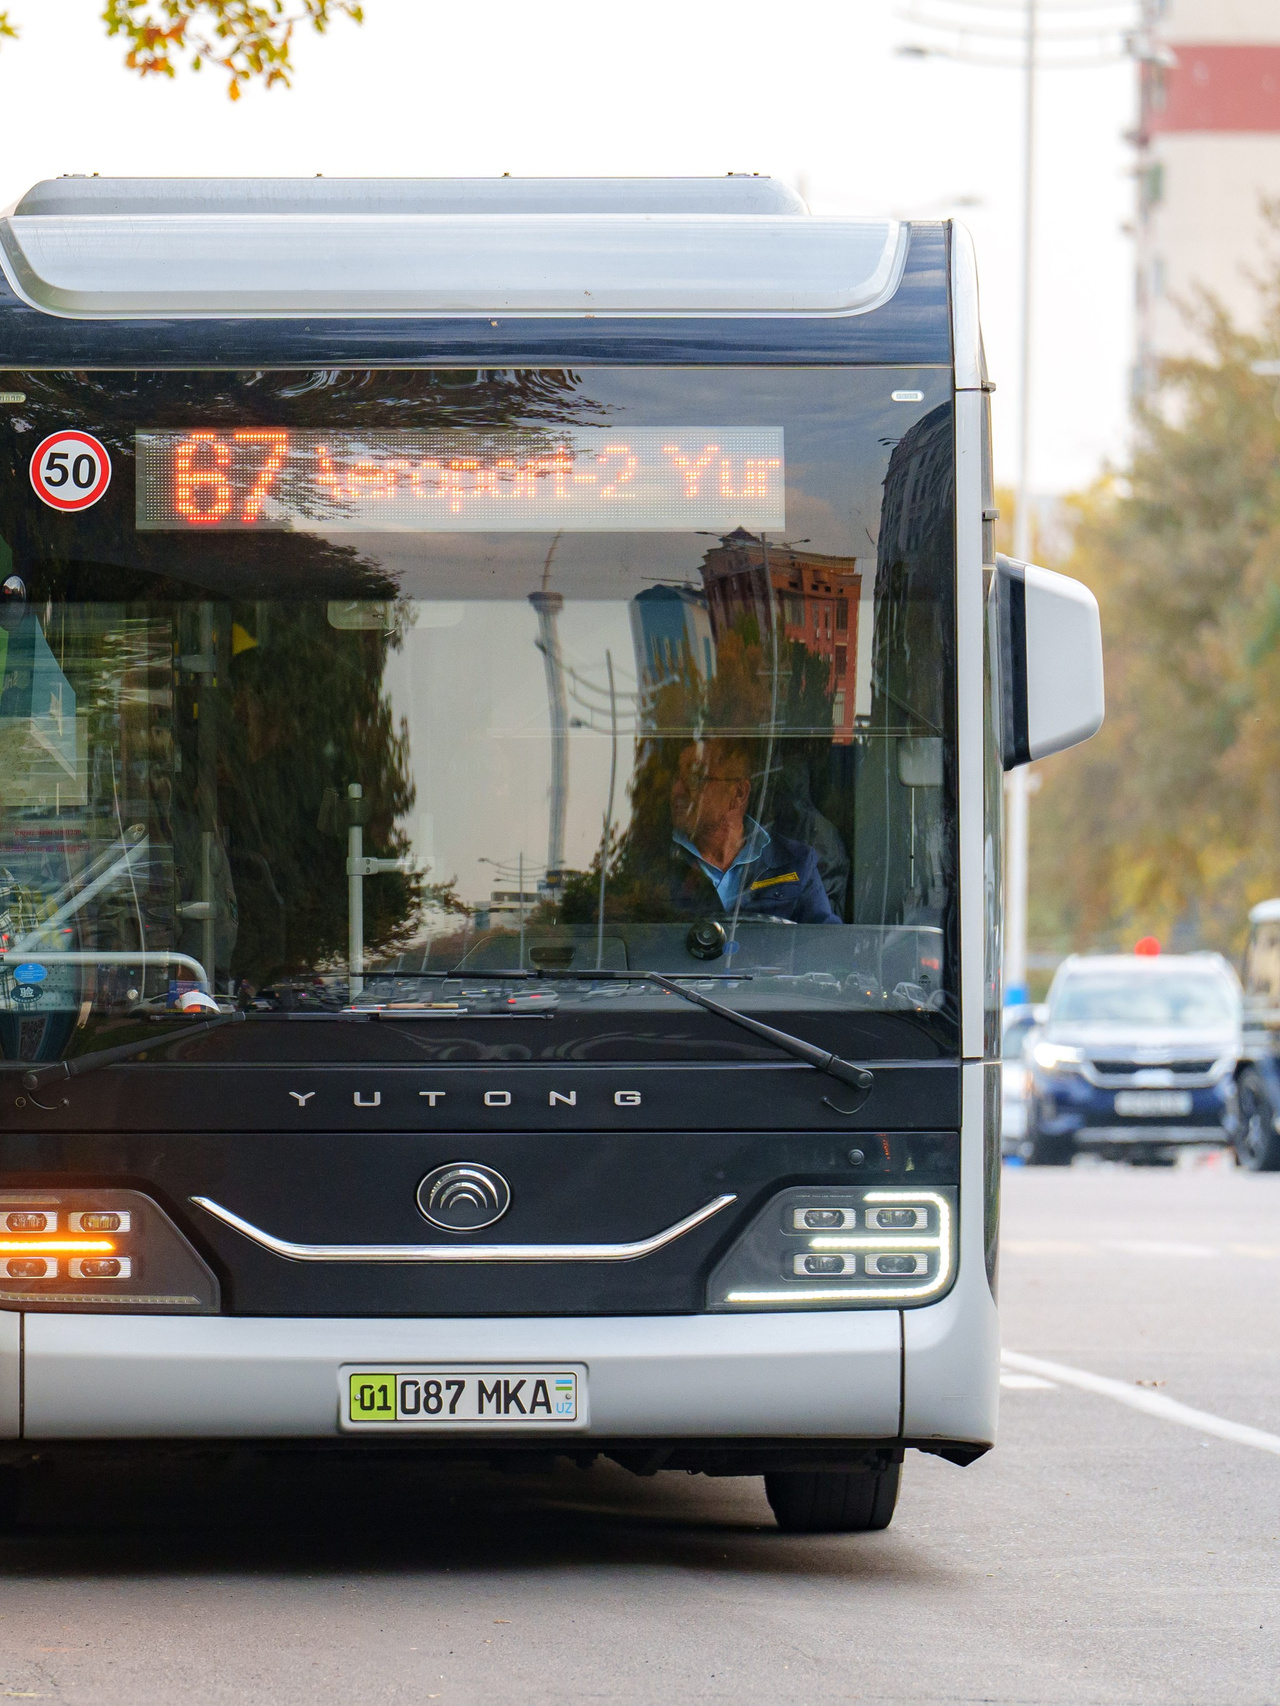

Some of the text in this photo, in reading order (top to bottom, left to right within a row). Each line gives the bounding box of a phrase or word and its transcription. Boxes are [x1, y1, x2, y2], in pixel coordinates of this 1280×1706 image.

[44, 452, 97, 489] 50
[288, 1091, 642, 1107] YUTONG
[359, 1379, 574, 1415] 01 087 MKA UZ
